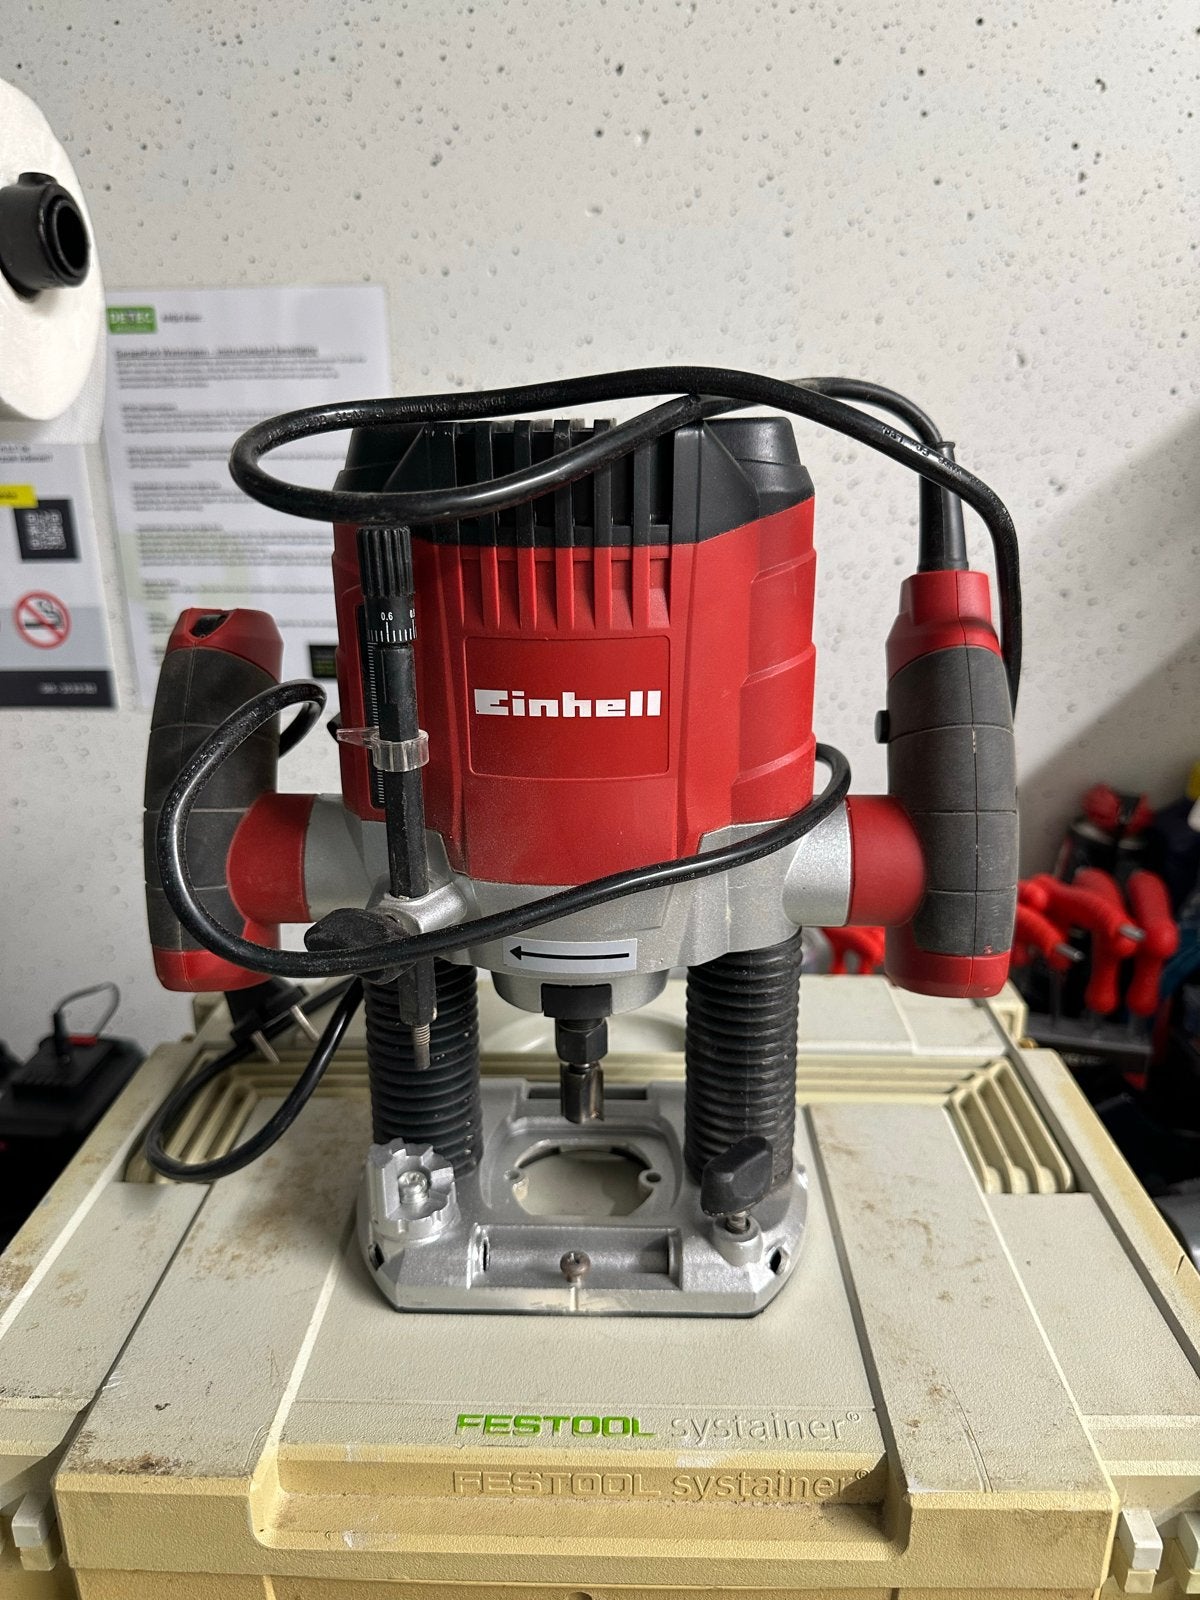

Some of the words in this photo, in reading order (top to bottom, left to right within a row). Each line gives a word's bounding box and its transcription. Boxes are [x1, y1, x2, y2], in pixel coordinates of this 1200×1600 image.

[380, 611, 394, 621] 0.6
[474, 688, 662, 718] Einhell
[455, 1413, 657, 1438] FESTOOL
[453, 1470, 662, 1496] FESTOOL
